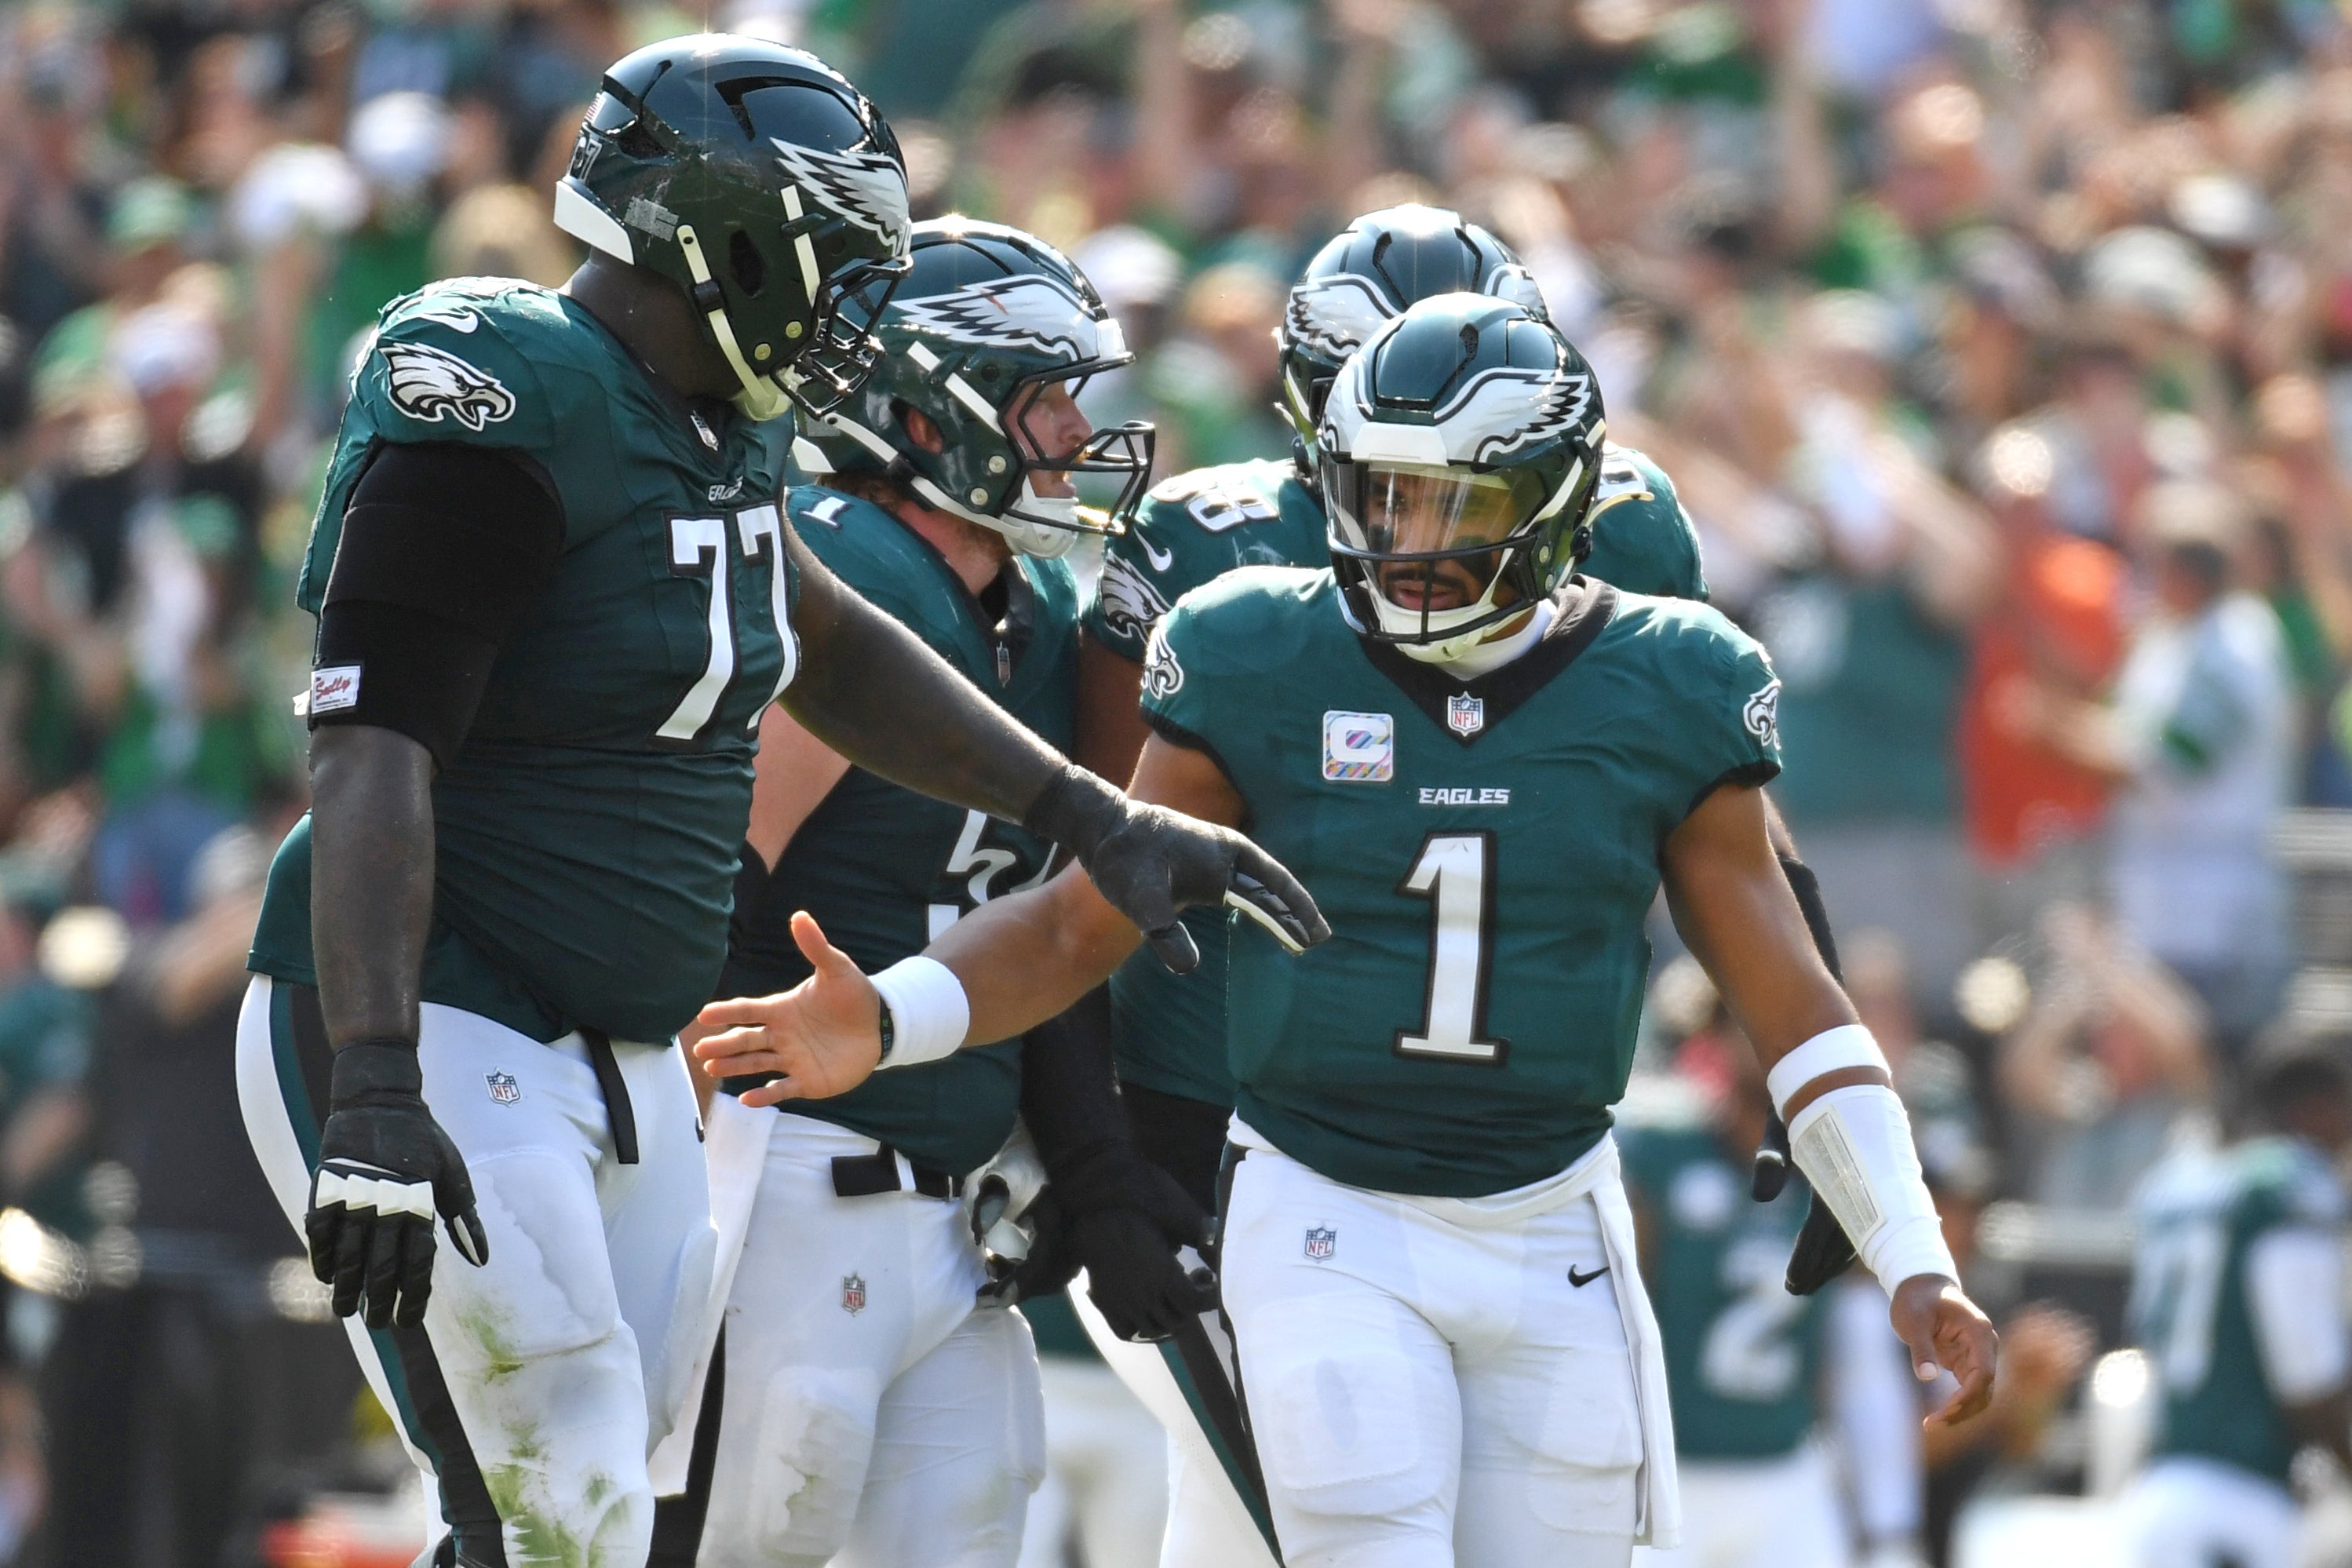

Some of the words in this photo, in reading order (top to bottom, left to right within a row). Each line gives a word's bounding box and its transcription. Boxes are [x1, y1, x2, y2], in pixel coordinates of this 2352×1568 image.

[656, 503, 799, 741] 77
[1453, 710, 1477, 727] NFL
[1329, 716, 1387, 764] C
[1418, 787, 1511, 805] EAGLES
[1397, 833, 1501, 1062] 1
[493, 1085, 518, 1099] NFL
[1307, 1241, 1332, 1256] NFL
